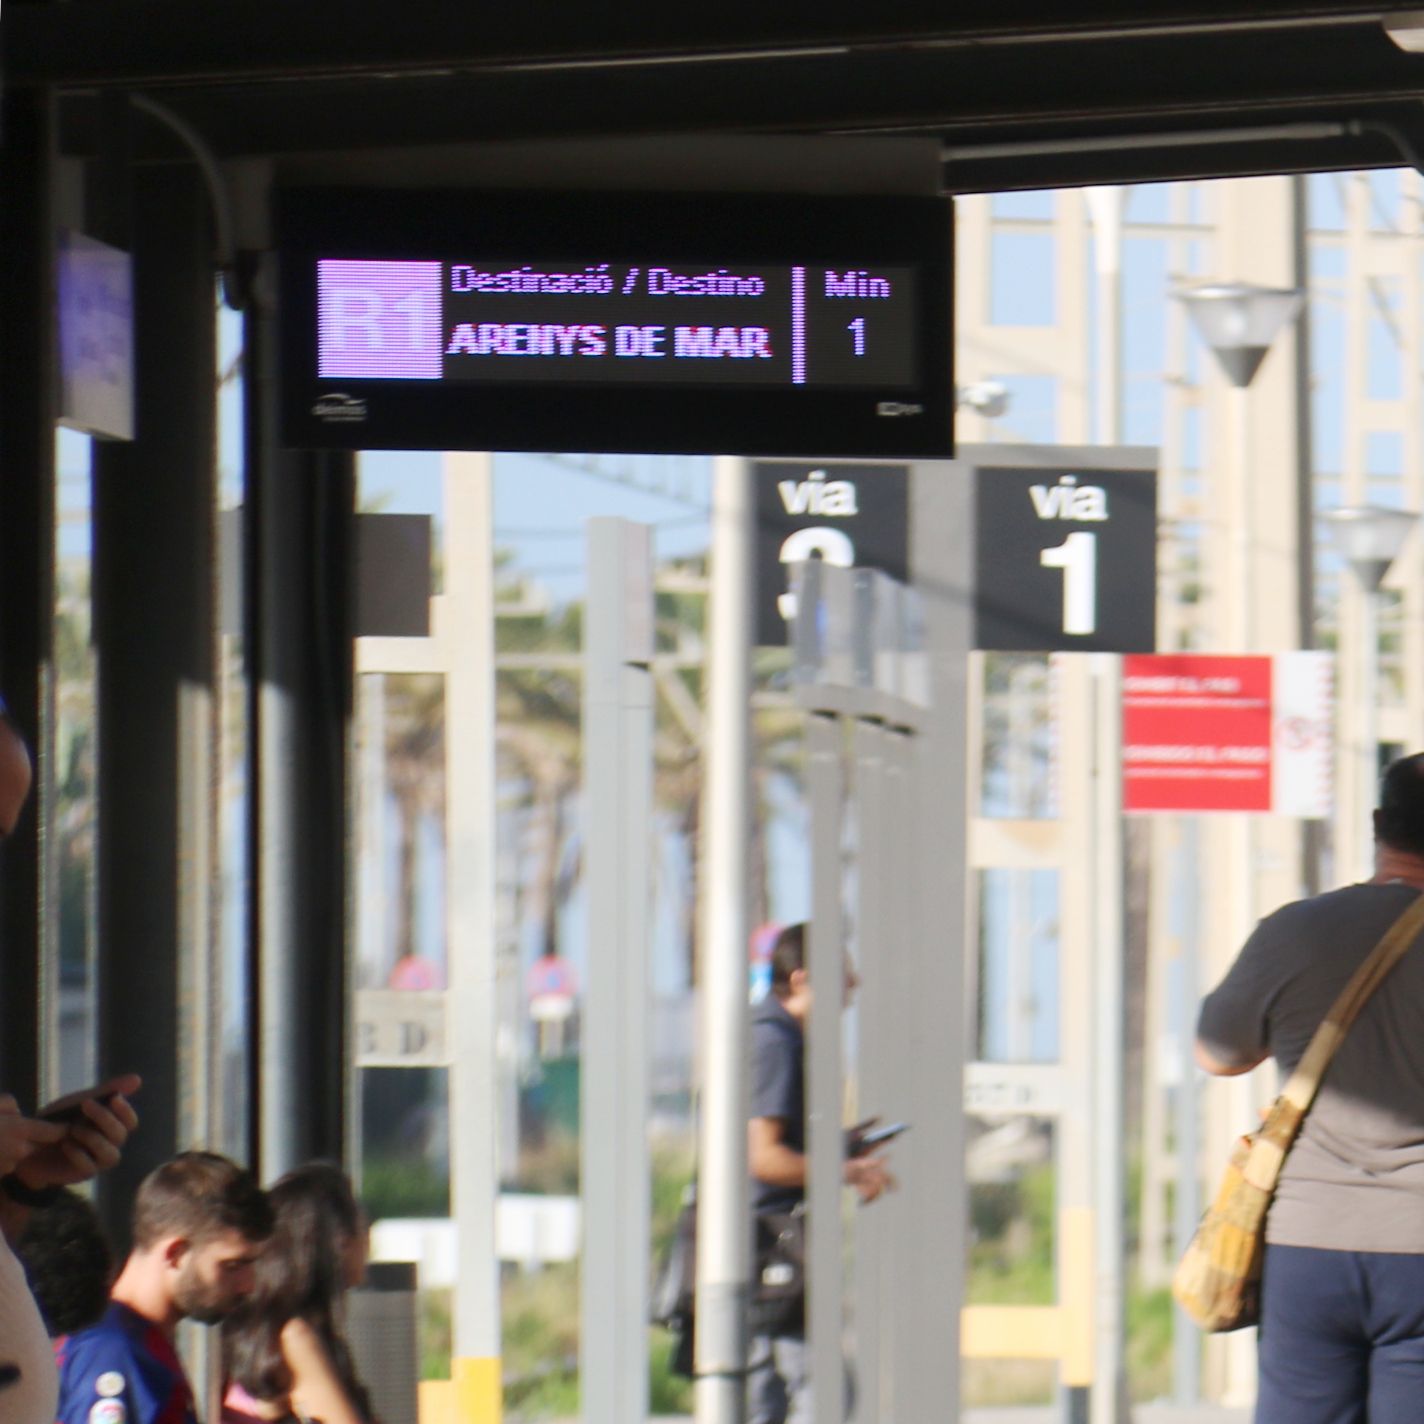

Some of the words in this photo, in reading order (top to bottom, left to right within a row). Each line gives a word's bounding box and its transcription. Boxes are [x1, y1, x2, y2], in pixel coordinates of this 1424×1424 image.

[451, 264, 613, 293] Destinació
[648, 268, 766, 296] Destino
[824, 270, 891, 298] Min
[334, 293, 426, 351] R1
[445, 323, 607, 356] ARENYS
[614, 325, 667, 357] DE
[674, 326, 773, 358] MAR
[847, 317, 866, 356] 1
[1039, 531, 1097, 635] 1
